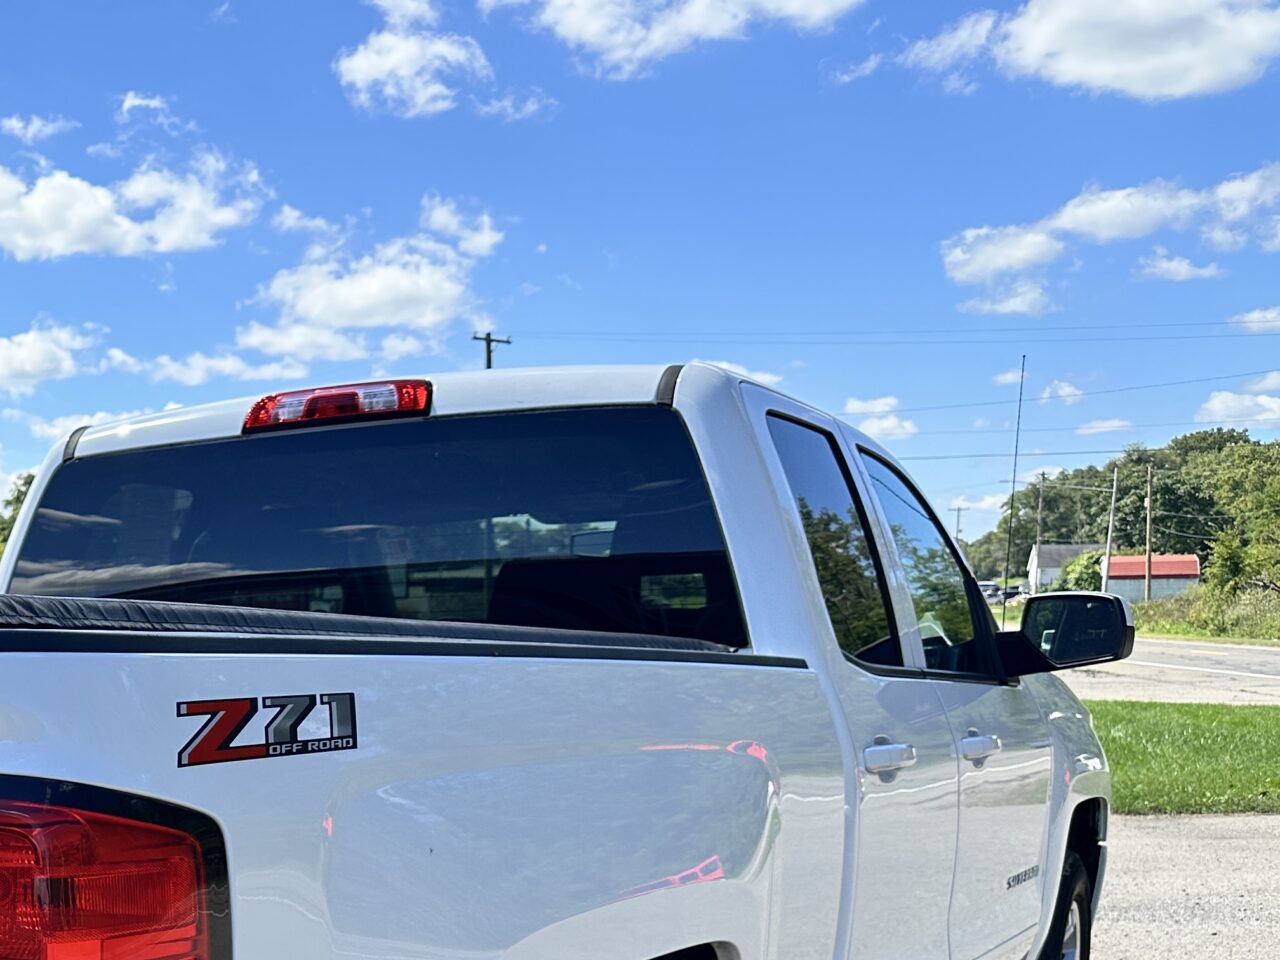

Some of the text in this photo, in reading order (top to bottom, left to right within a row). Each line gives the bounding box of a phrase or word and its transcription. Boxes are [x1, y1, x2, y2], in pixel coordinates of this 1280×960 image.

[176, 692, 356, 768] Z71
[269, 738, 353, 755] OFF ROAD
